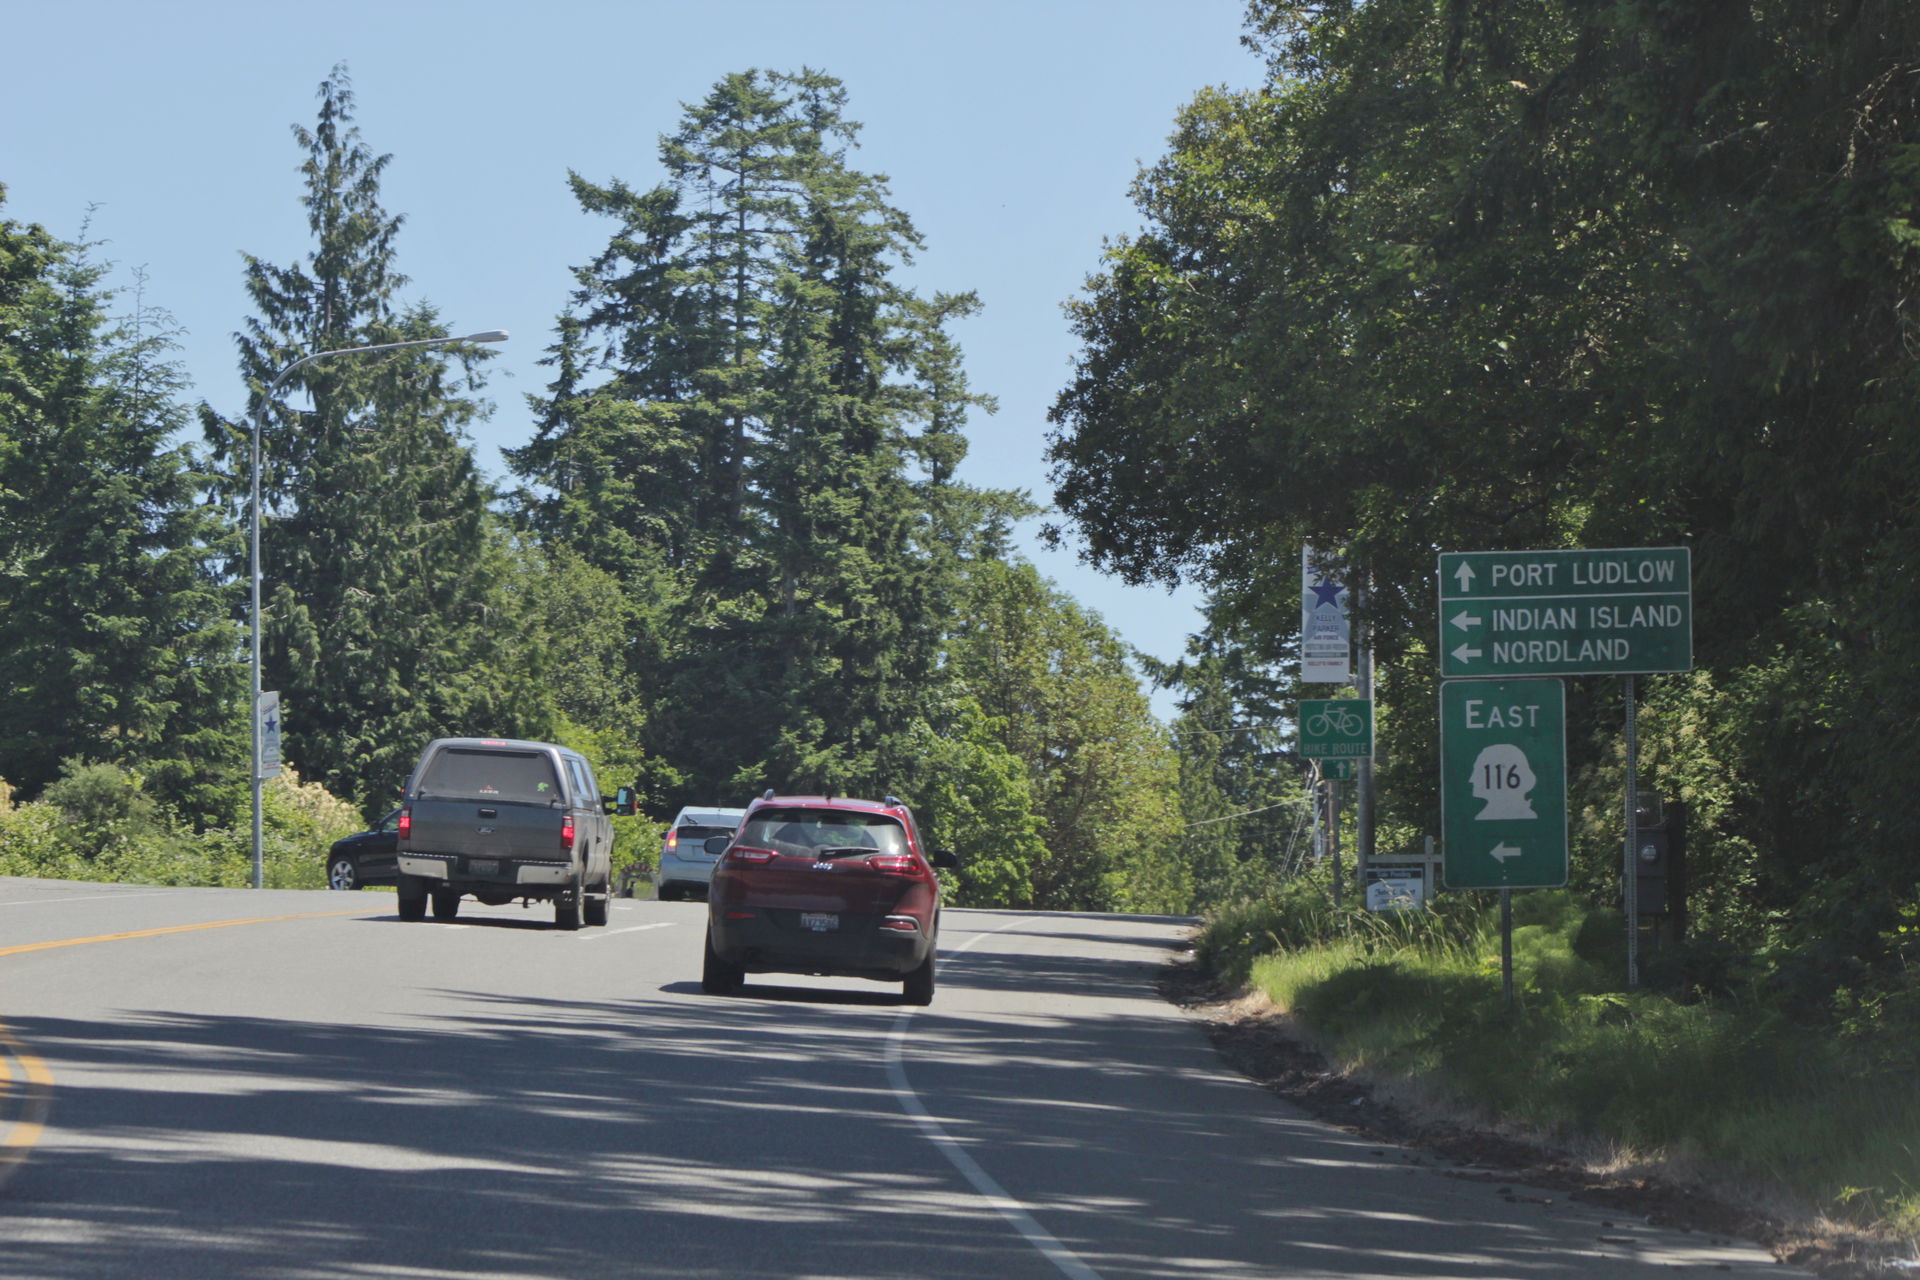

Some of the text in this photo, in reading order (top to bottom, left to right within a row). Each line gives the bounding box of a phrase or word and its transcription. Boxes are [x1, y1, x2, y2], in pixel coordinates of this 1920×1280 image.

[1492, 560, 1675, 587] PORT LUDLOW
[1493, 605, 1682, 631] INDIAN ISLAND
[1493, 639, 1629, 664] NORDLAND
[1466, 700, 1539, 728] EAST
[1304, 743, 1367, 755] BIKE ROUTE
[1484, 764, 1521, 790] 116
